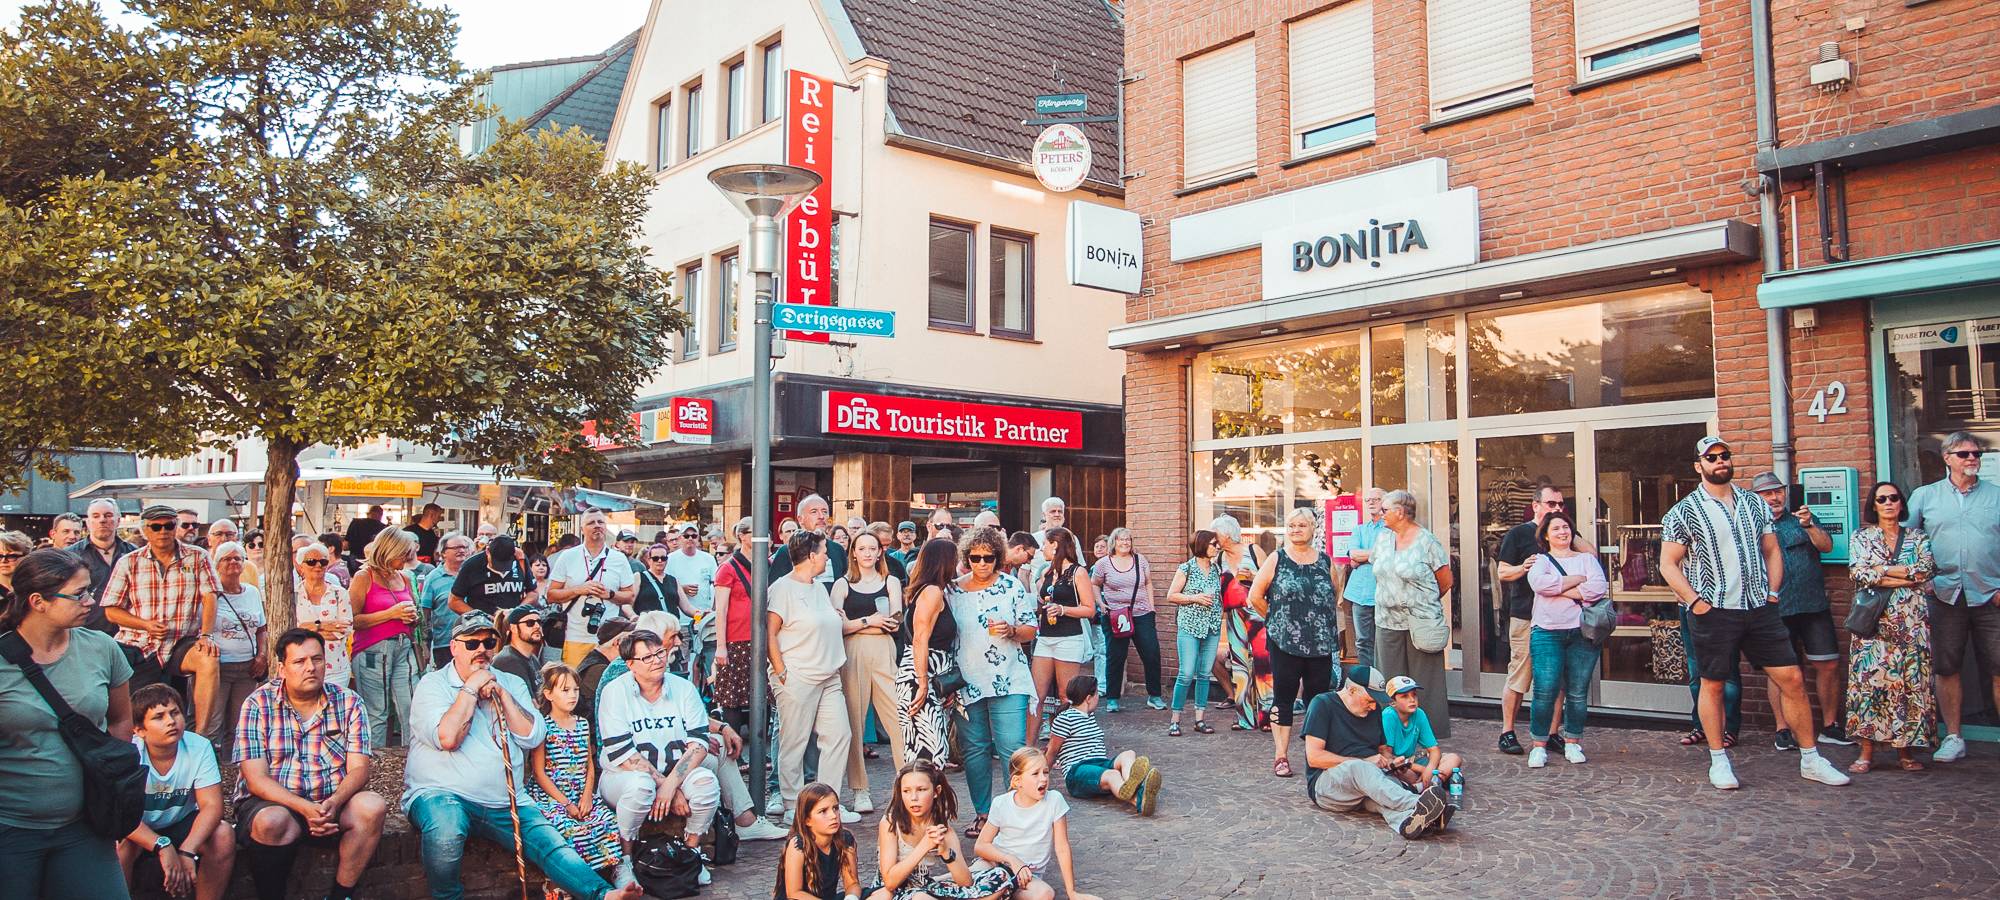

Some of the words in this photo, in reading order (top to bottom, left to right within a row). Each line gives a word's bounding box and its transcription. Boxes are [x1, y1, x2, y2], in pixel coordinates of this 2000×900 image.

[798, 76, 824, 335] Reiebür
[781, 308, 884, 331] Derigsgasse
[1893, 330, 1938, 341] DIABETICA
[1808, 381, 1847, 422] 42
[679, 421, 708, 429] Touristik
[886, 409, 985, 438] Touristik
[994, 417, 1069, 443] Partner
[484, 581, 523, 594] BMW
